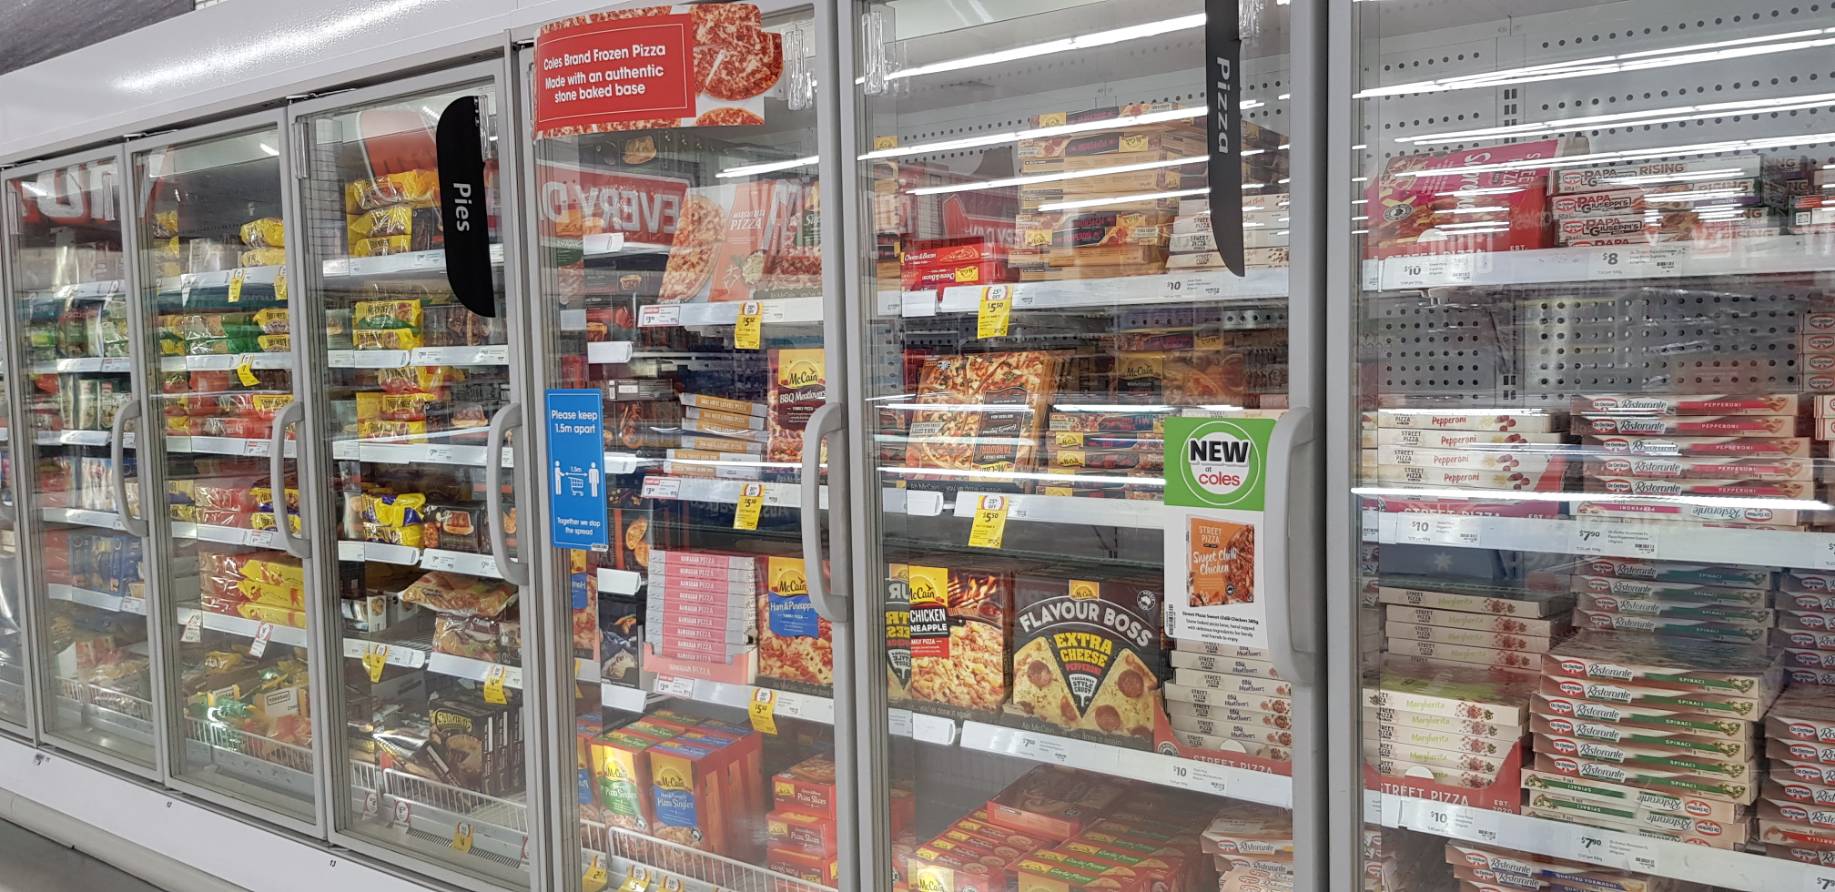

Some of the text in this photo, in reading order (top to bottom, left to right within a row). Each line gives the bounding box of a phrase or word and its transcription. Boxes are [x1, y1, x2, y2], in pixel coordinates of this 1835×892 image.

[544, 44, 665, 70] Coles Brand Frozen Pizza
[545, 65, 664, 89] Made with an authentic
[554, 82, 645, 103] stone baked base
[1217, 57, 1231, 154] Pizza
[1584, 169, 1617, 180] PAPA
[1640, 164, 1684, 175] RISING
[1577, 195, 1610, 205] PAPA
[453, 183, 472, 232] Pies
[1585, 218, 1620, 228] PAPA
[1602, 252, 1618, 265] $8
[1404, 265, 1421, 276] $10
[1167, 281, 1181, 291] $10
[789, 372, 817, 384] McCain
[780, 392, 794, 403] BBQ
[552, 410, 597, 421] Please keep
[1431, 416, 1467, 425] Pepperoni
[555, 424, 595, 435] 1.5m apart
[1620, 420, 1665, 432] Ristorante
[1441, 435, 1477, 445] Pepperoni
[1189, 439, 1249, 464] NEW
[1433, 455, 1469, 465] Pepperoni
[1634, 461, 1681, 473] Ristorante
[1199, 472, 1240, 486] coles
[1444, 472, 1479, 483] Pepperoni
[1635, 481, 1681, 493] Ristorante
[558, 517, 579, 527] Together
[589, 519, 600, 528] stop
[1412, 521, 1429, 531] $10
[1199, 526, 1222, 536] STREET
[1202, 534, 1220, 544] PIZZA
[1193, 551, 1217, 564] Sweet
[1200, 562, 1229, 575] Chicken
[910, 587, 935, 601] cCain
[910, 608, 946, 622] CHICKEN
[911, 624, 948, 632] NEAPPLE
[1018, 602, 1152, 647] FLAVOUR BOSS
[1053, 632, 1113, 654] EXTRA
[1060, 649, 1108, 667] CHEESE
[1589, 663, 1632, 677] Ristorante
[1073, 681, 1094, 689] STYLE
[1074, 686, 1092, 694] CRUST
[1587, 686, 1631, 699] Ristorante
[1406, 699, 1445, 709] Margherita
[1576, 703, 1619, 719] Ristorante
[1412, 715, 1450, 725] Margherita
[1665, 719, 1692, 727] SPINACI
[1576, 724, 1619, 739] Ristorante
[1411, 734, 1449, 744] Margherita
[1665, 739, 1691, 747] SPINACI
[1580, 743, 1624, 758] Ristorante
[1670, 760, 1696, 768] SPINACI
[1173, 766, 1186, 777] $10
[1582, 763, 1625, 778] Ristorante
[1670, 780, 1697, 788] SPINACI
[658, 798, 694, 809] Pizza Singles
[1431, 790, 1469, 806] PIZZA
[1431, 811, 1447, 823] $10
[1490, 858, 1531, 874] Ristorante
[1499, 873, 1539, 887] Ristorante
